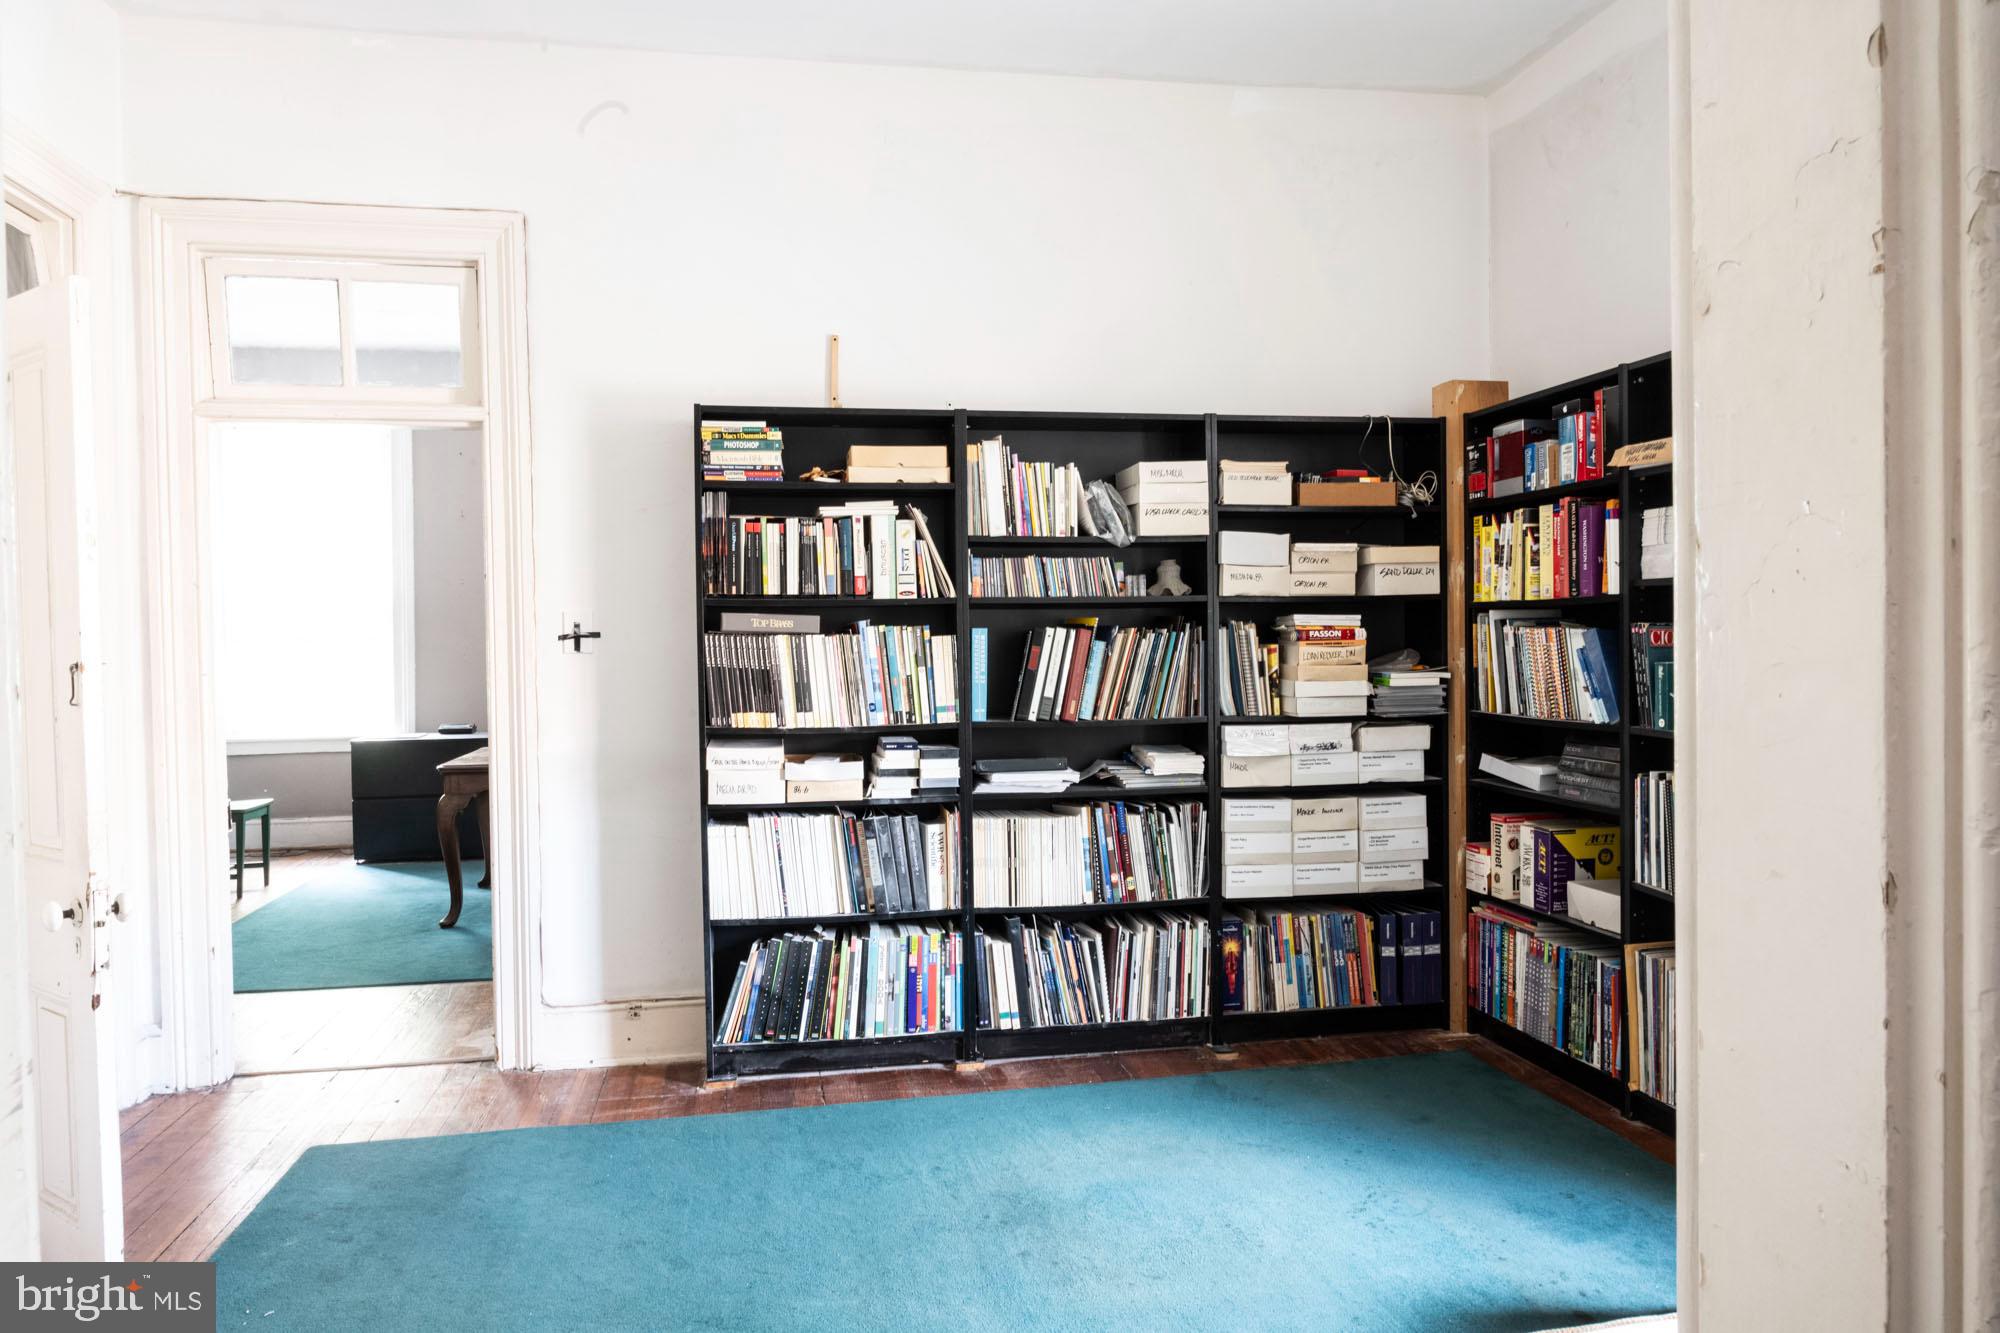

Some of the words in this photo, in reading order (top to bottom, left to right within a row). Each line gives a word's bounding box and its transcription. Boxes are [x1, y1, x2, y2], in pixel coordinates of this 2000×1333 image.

[723, 441, 760, 449] PHOTOSHOP
[751, 617, 769, 628] TOP
[1585, 833, 1616, 846] ACT!
[1494, 823, 1503, 869] Internet
